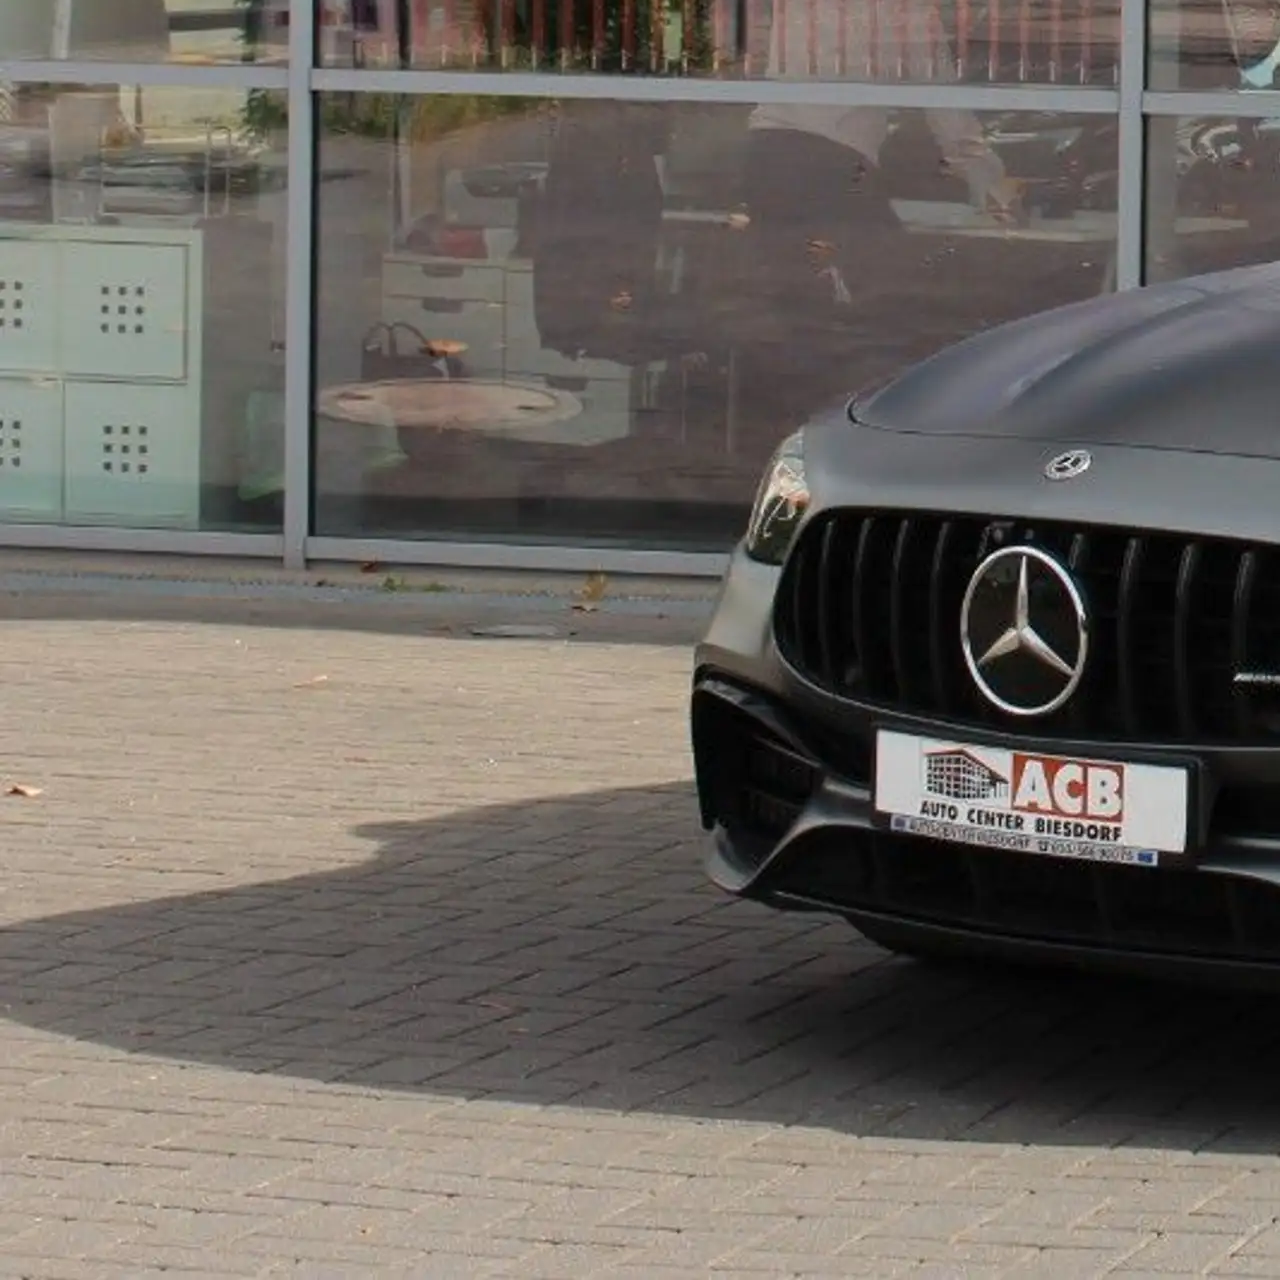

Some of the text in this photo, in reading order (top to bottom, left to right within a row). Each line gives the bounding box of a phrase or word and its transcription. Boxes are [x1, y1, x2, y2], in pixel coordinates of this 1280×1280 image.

[1013, 759, 1122, 817] ACB
[920, 800, 1122, 841] AUTO CENTER BIESDORF
